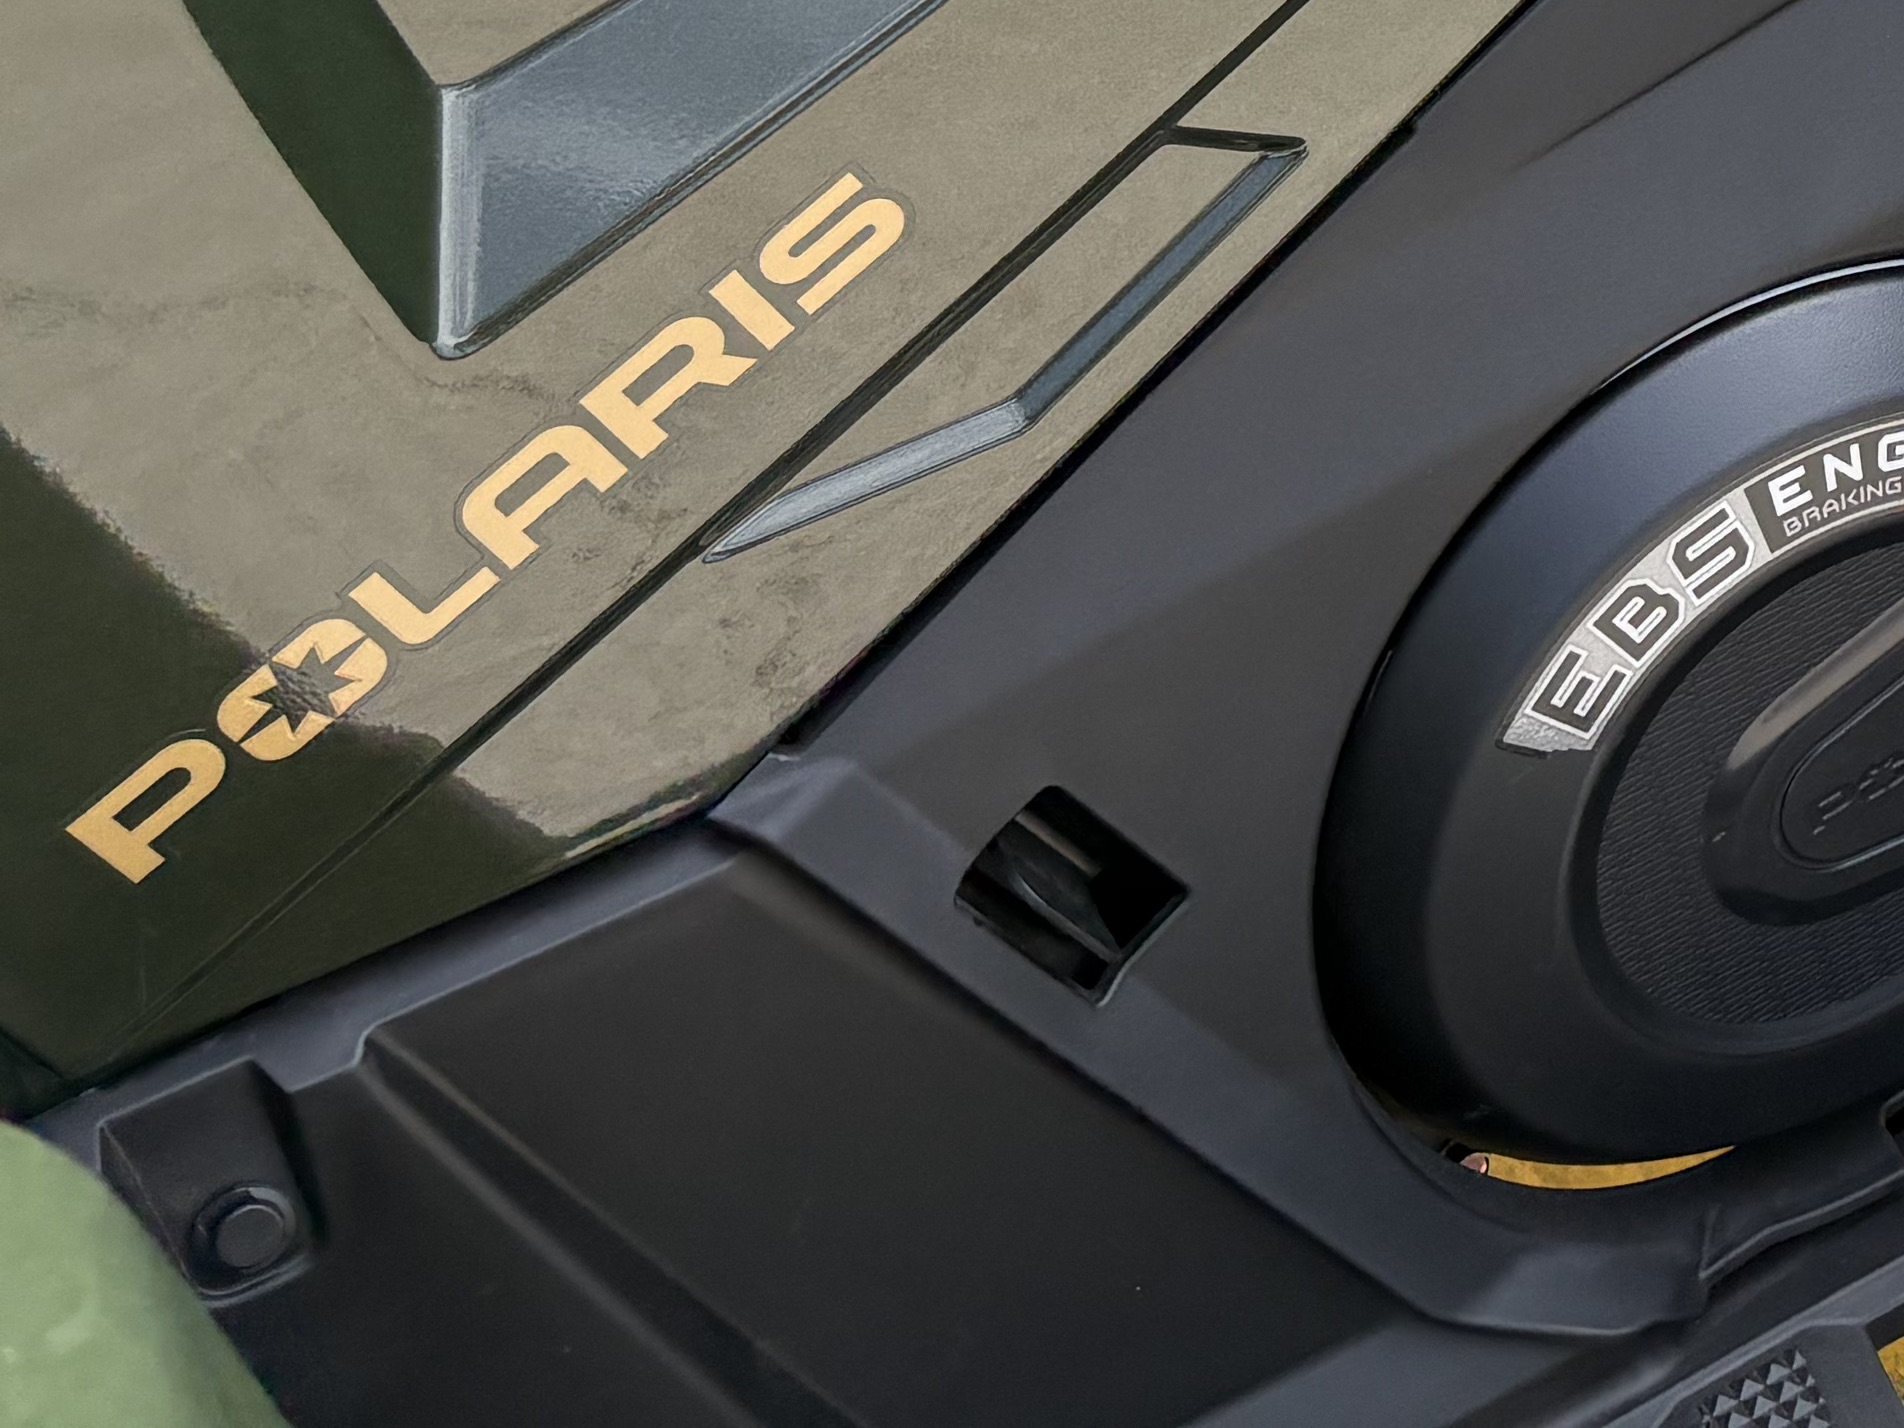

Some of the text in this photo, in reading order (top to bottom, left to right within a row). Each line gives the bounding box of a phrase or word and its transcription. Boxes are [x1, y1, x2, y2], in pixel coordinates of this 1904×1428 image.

[65, 171, 906, 884] POLARIS
[1524, 500, 1756, 741] EBS
[1782, 475, 1903, 538] BRAKING
